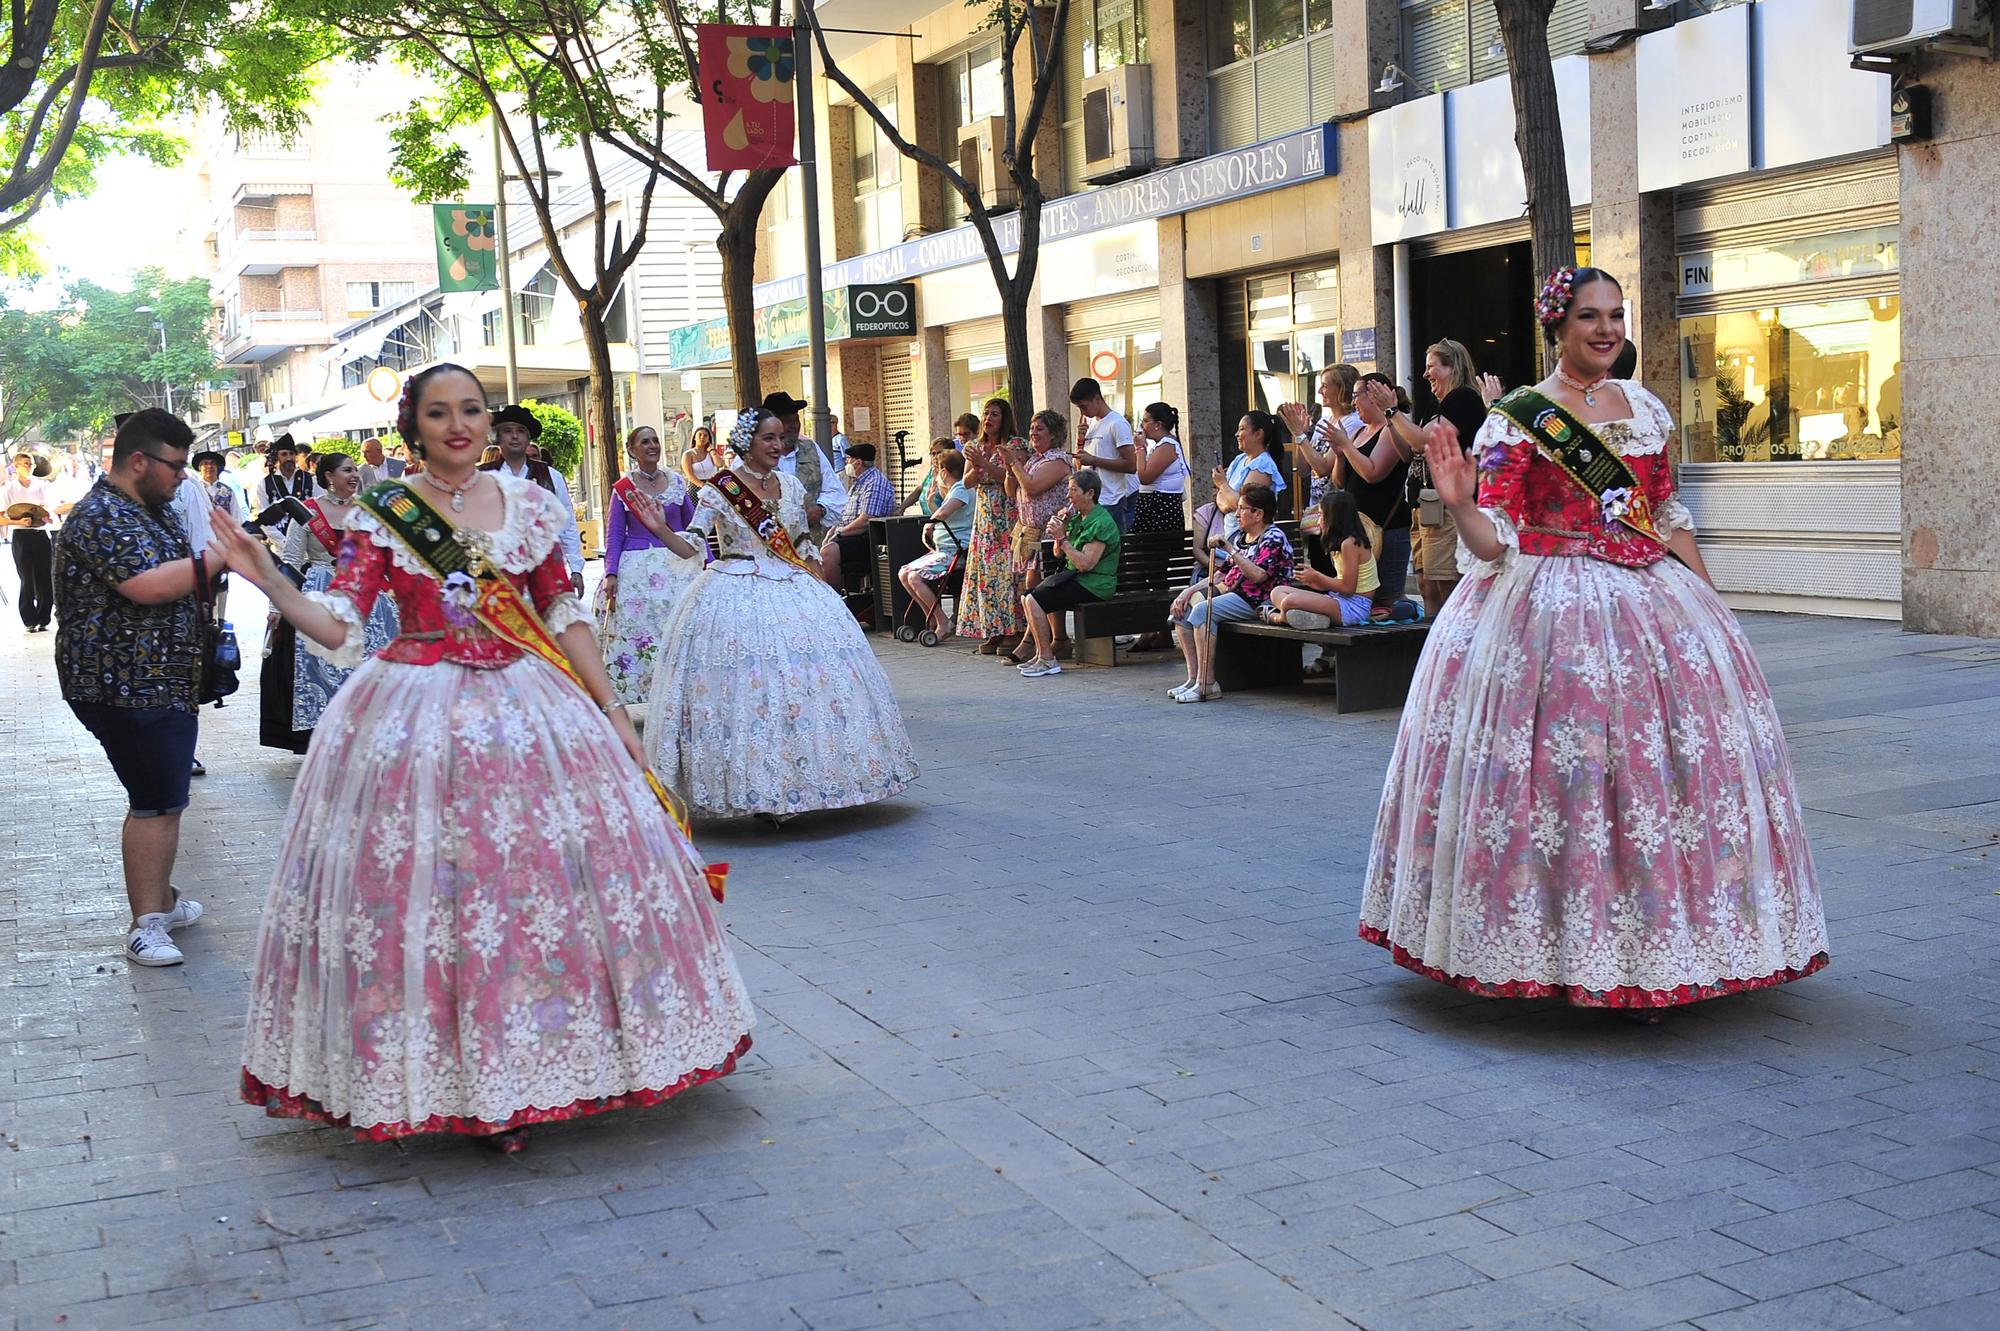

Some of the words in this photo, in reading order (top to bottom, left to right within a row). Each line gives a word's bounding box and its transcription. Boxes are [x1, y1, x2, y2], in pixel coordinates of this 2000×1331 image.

[1681, 94, 1743, 116] INTERIORISMO
[862, 248, 908, 284] FISCAL
[1003, 201, 1079, 248] FUNTES
[1093, 176, 1170, 226] ANDRES
[1175, 143, 1288, 206] ASESORES
[856, 321, 910, 331] FEDEROPTICOS
[1722, 442, 1785, 457] PROYECOS
